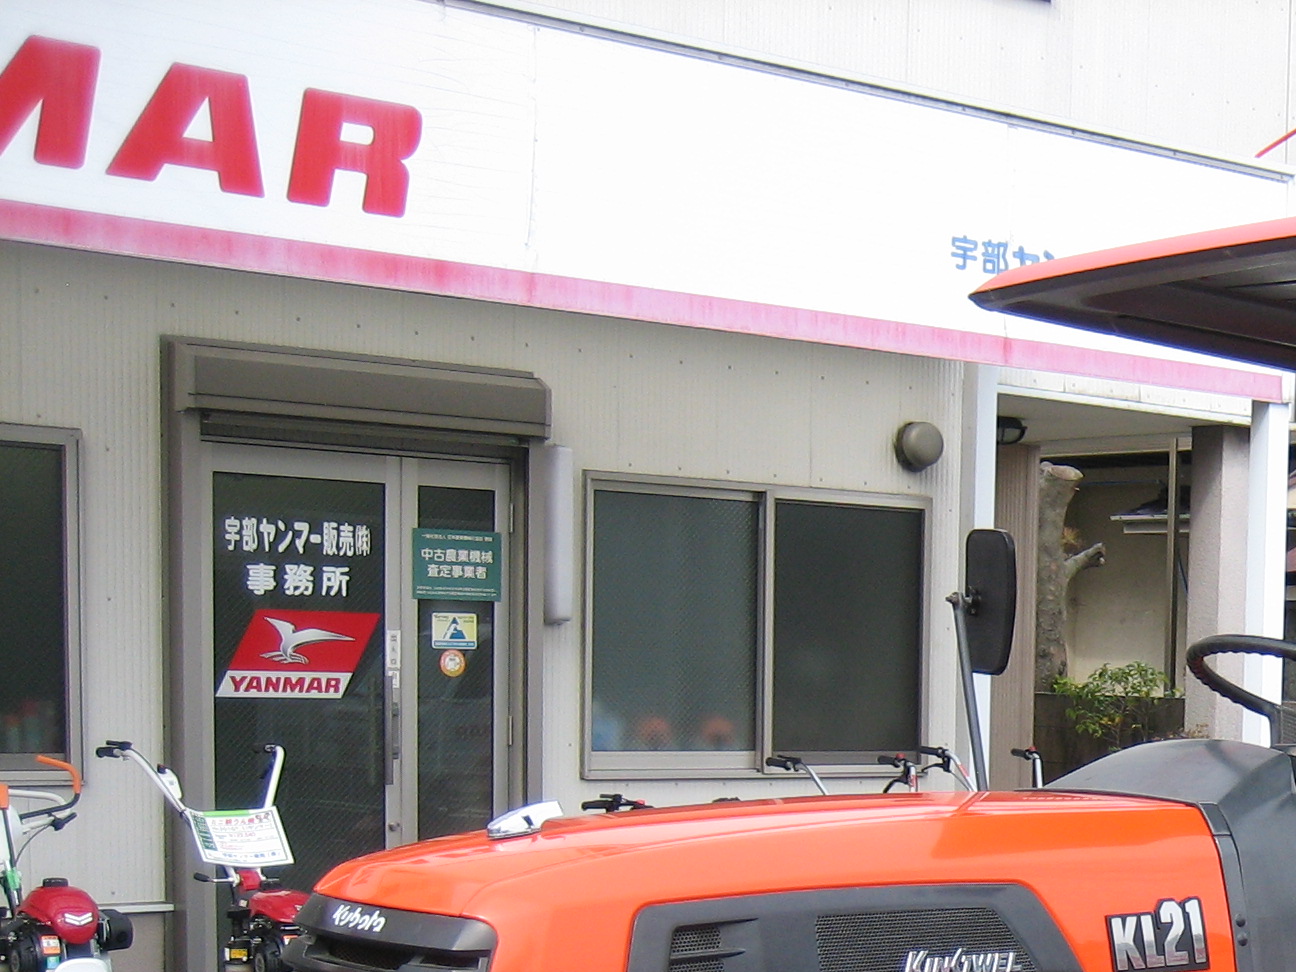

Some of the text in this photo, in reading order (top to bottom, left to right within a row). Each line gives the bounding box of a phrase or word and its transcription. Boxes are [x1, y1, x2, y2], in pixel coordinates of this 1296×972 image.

[246, 563, 351, 598] 事務所
[228, 675, 343, 694] YANMAR
[332, 904, 387, 933] Kubota
[1110, 899, 1206, 972] KL21
